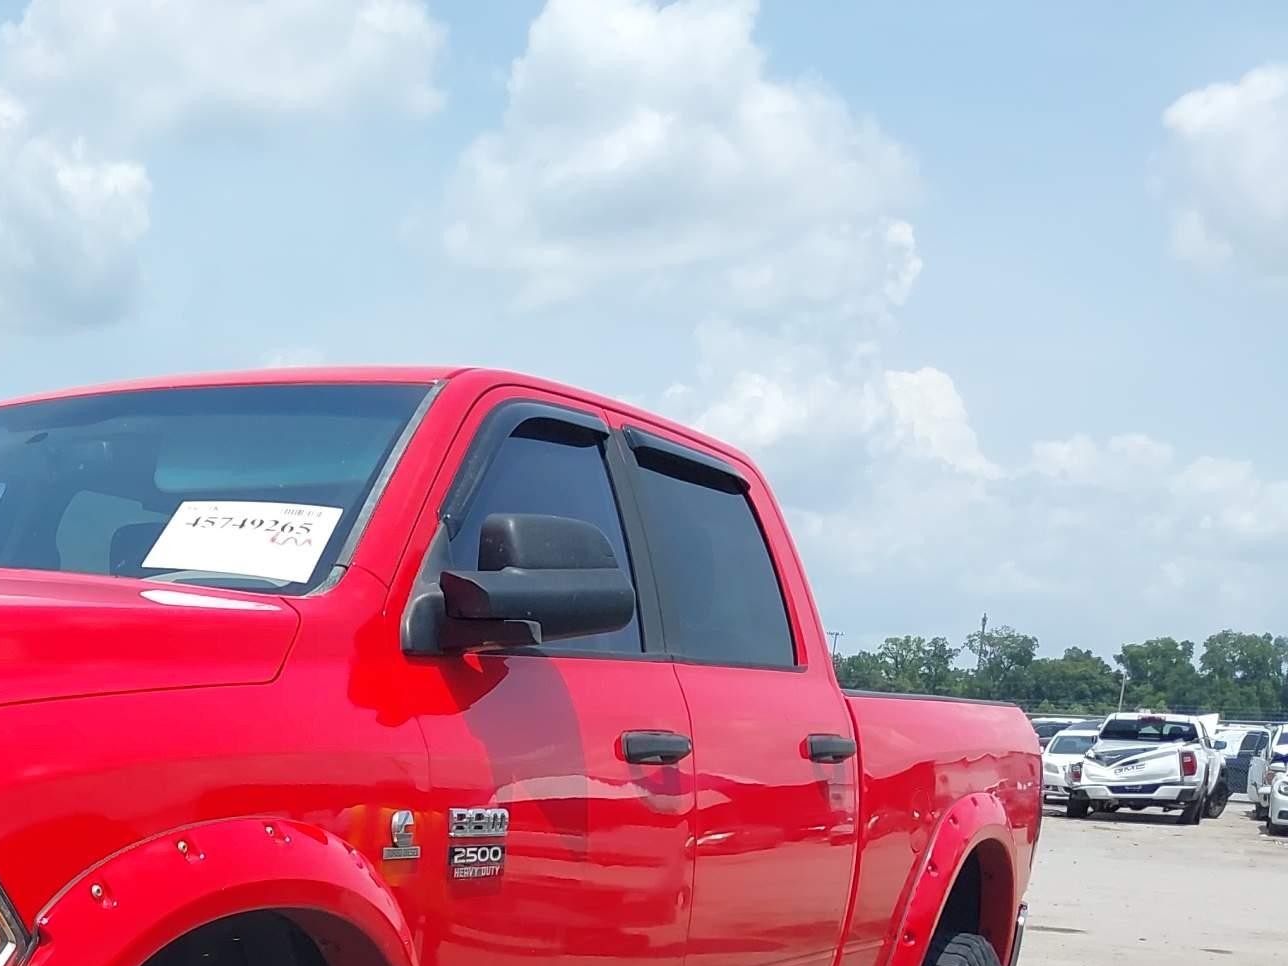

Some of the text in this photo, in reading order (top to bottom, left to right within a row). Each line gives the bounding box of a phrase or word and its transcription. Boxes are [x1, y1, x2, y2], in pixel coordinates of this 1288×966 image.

[185, 515, 313, 536] 45749265
[449, 807, 509, 836] RAM
[454, 847, 502, 864] 2500
[454, 865, 501, 878] HEAVY DUTY
